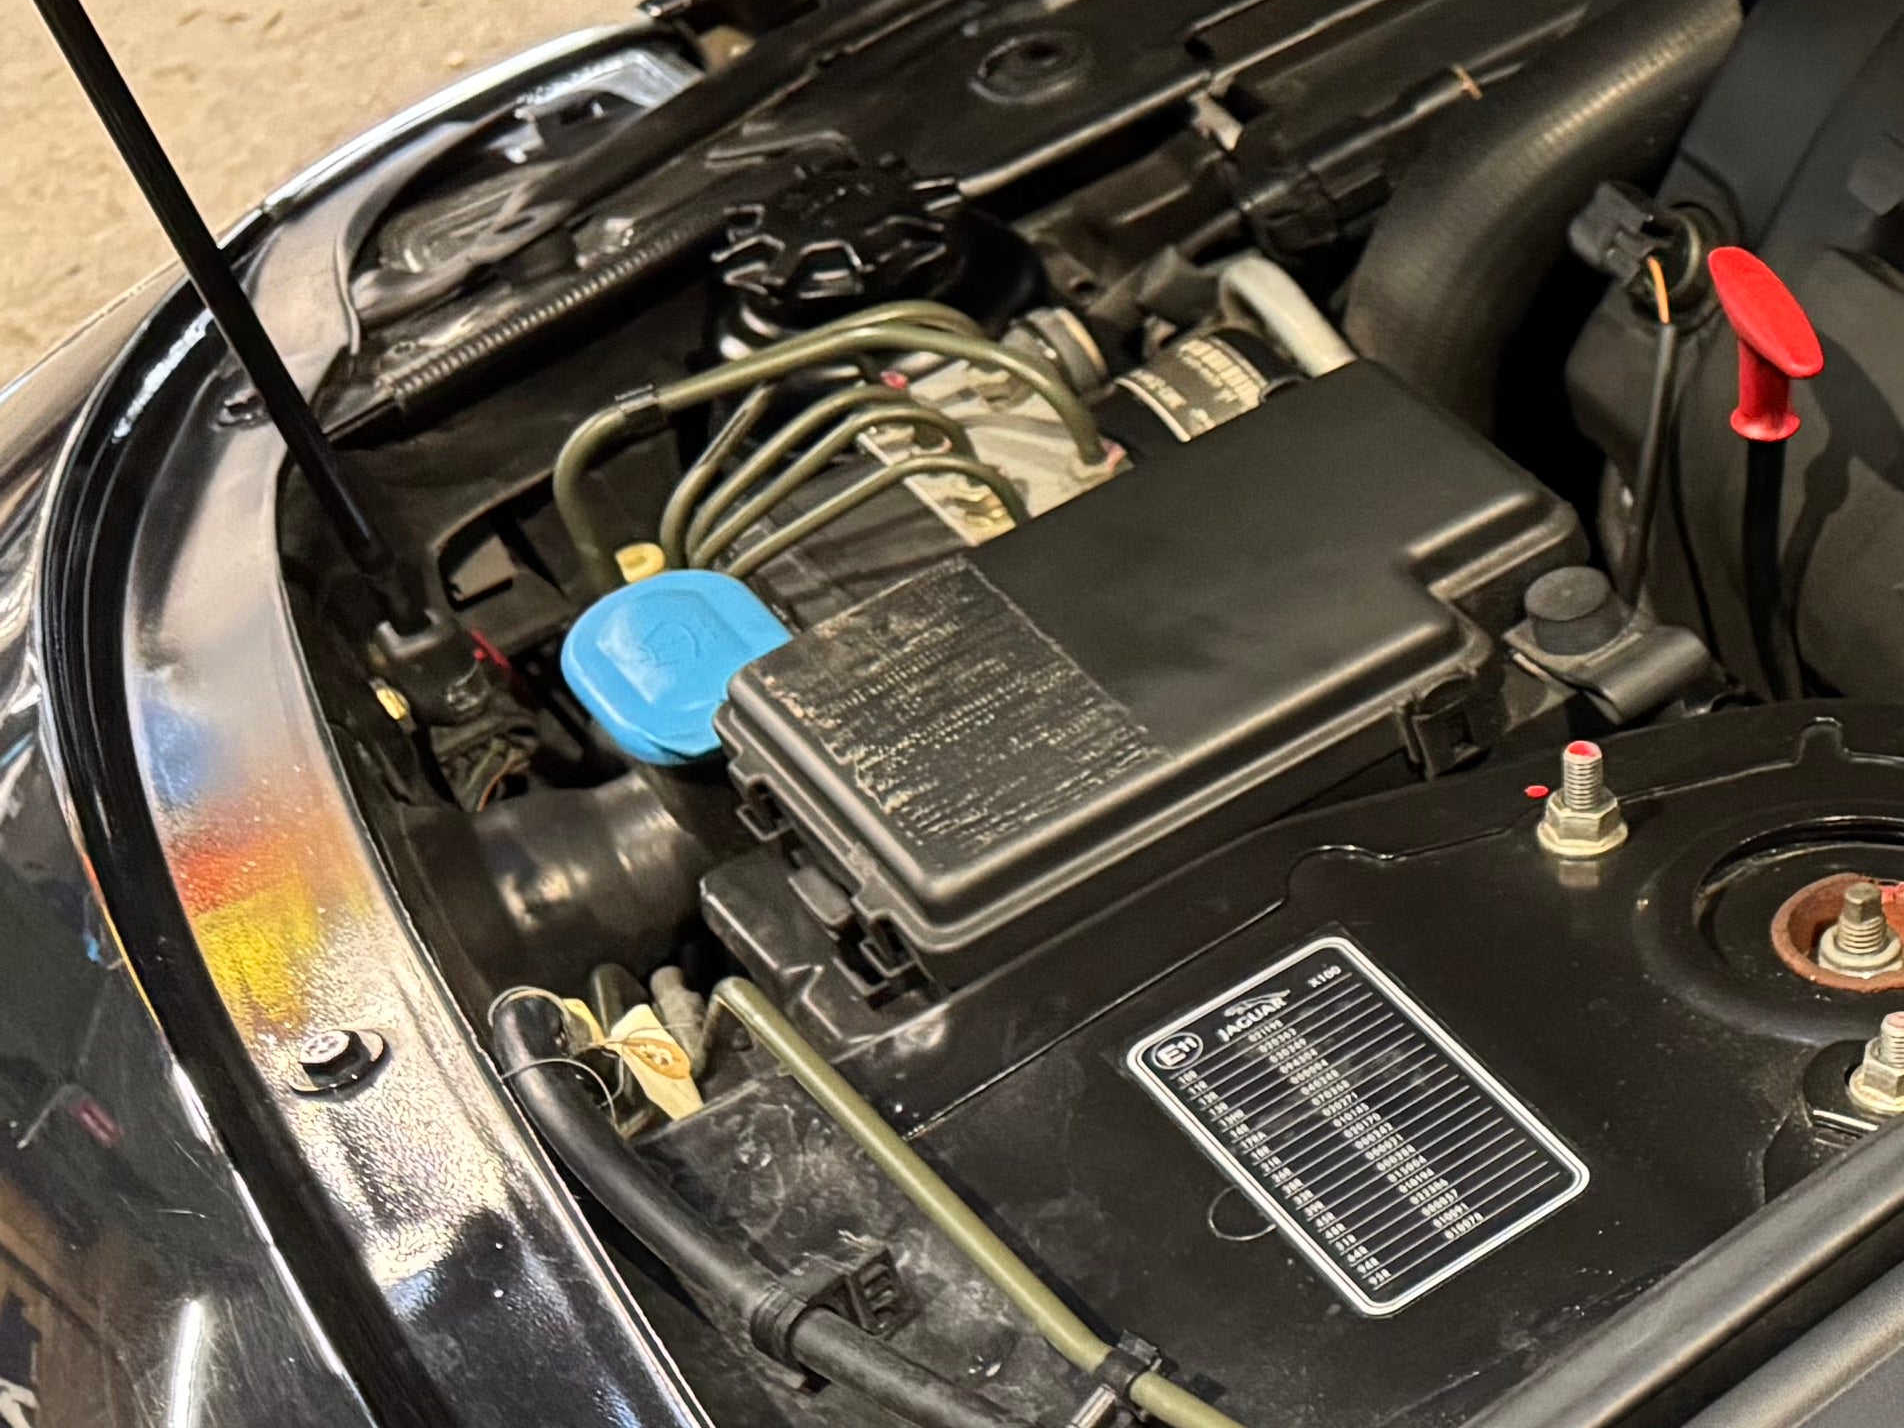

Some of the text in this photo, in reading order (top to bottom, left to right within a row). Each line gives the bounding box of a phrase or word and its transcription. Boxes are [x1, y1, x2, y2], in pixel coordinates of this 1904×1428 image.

[1306, 964, 1343, 989] X100
[1216, 995, 1289, 1043] JAGUAR
[1156, 1036, 1198, 1067] E11
